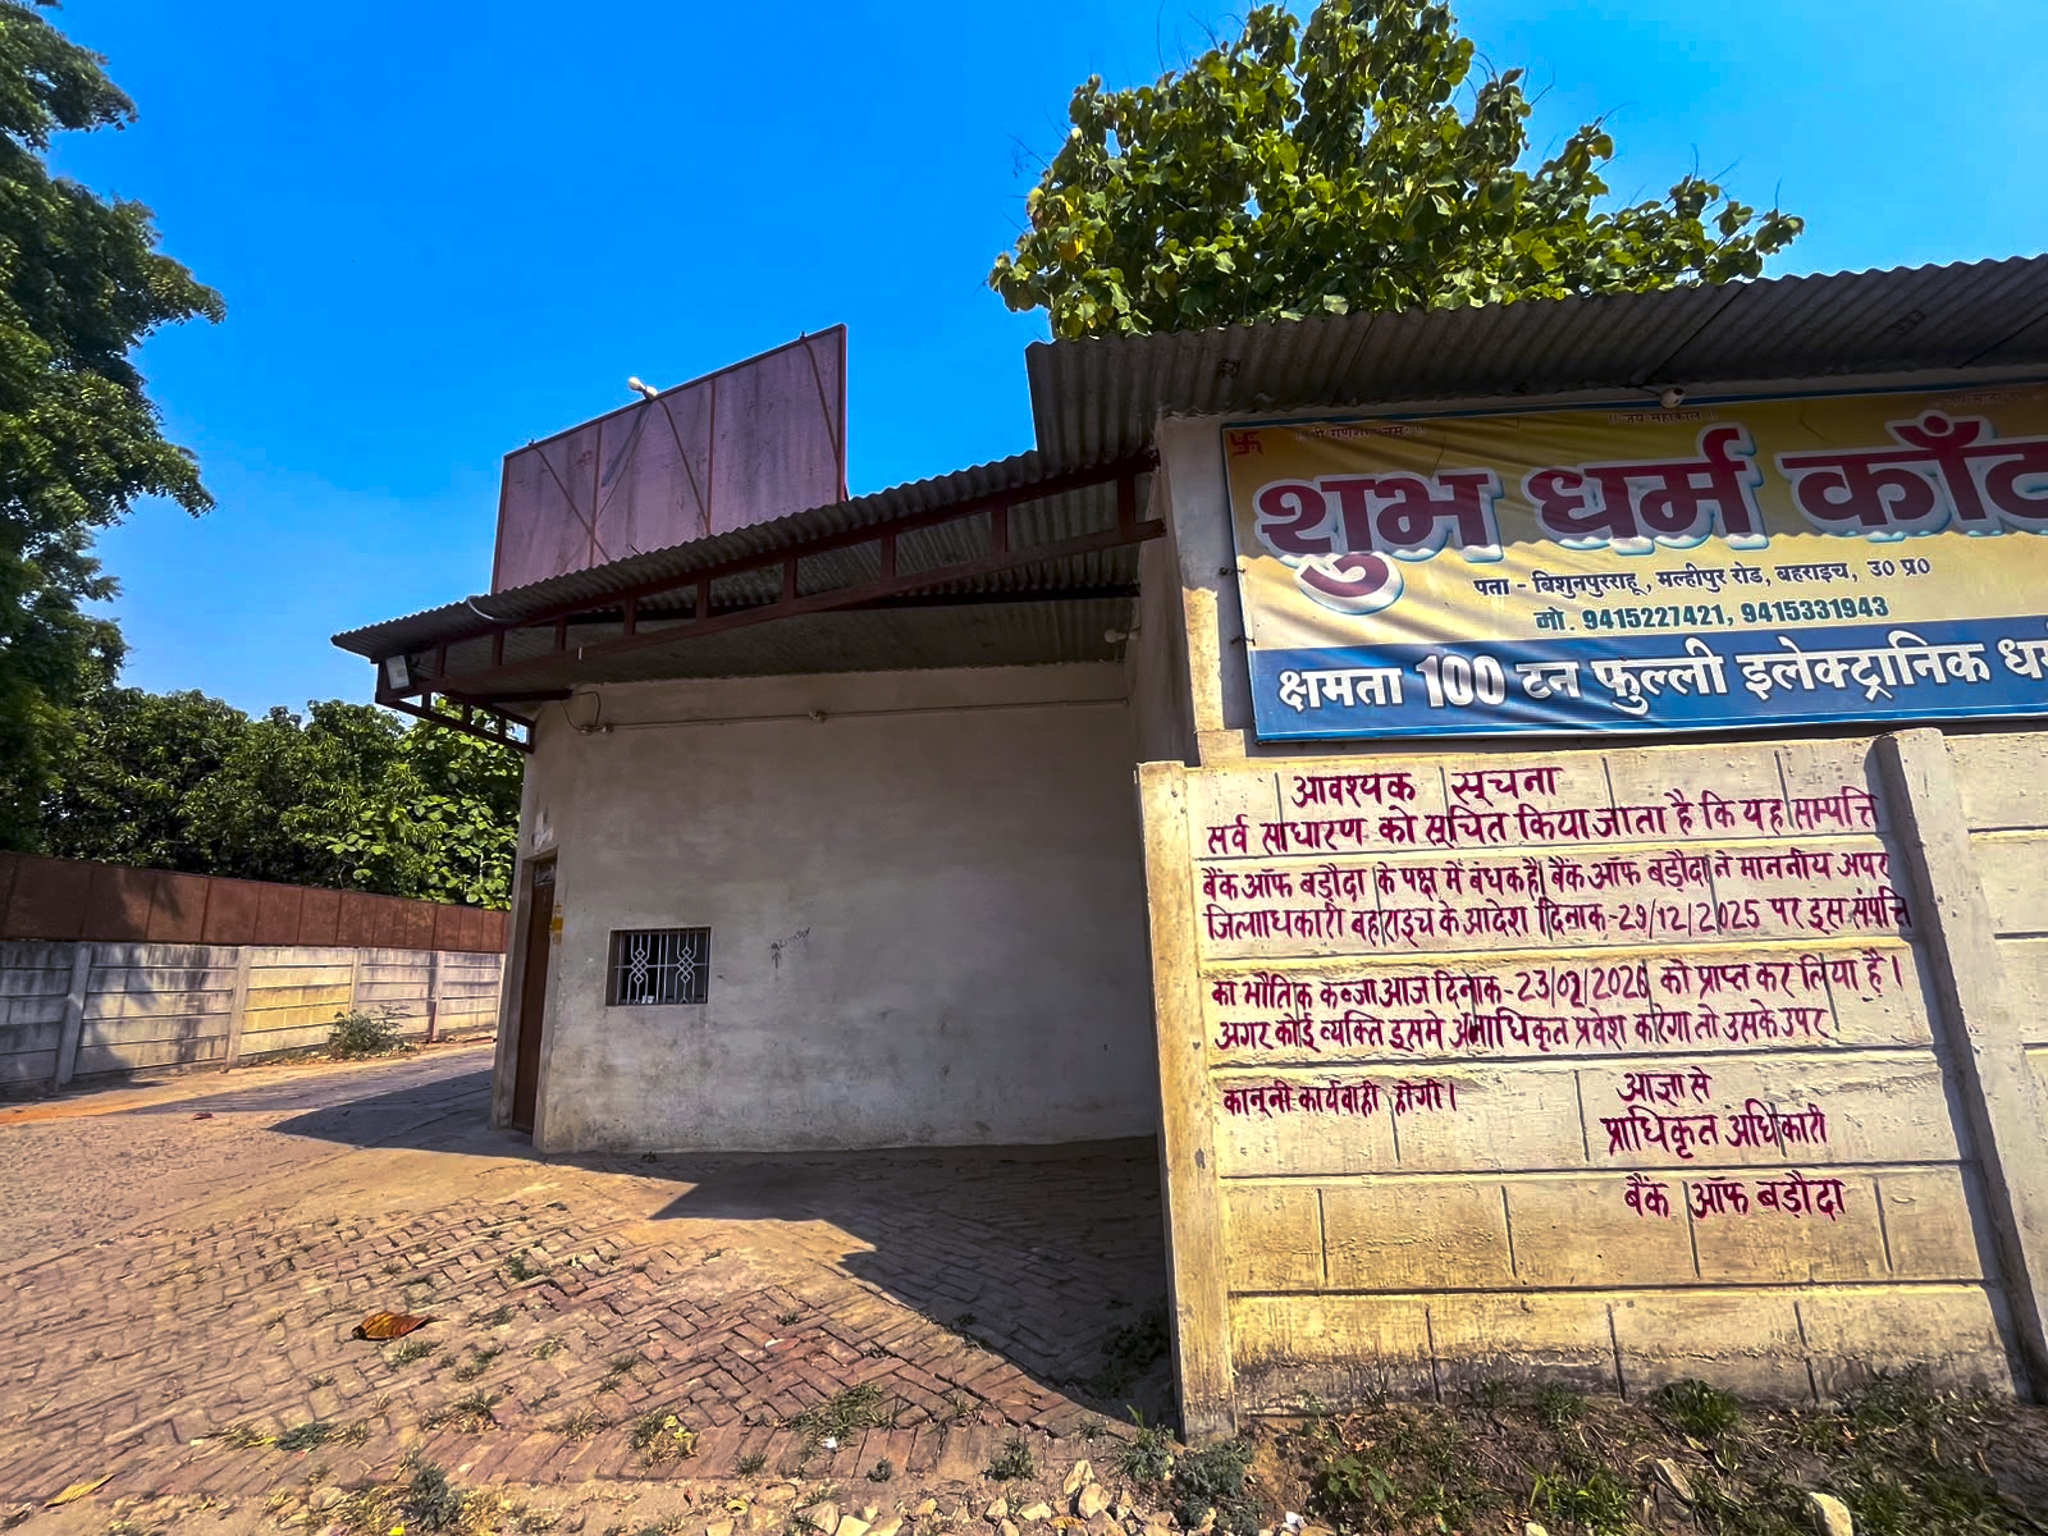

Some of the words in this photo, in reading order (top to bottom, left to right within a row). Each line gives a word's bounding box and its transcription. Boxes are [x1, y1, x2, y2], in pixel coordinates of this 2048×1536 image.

[1259, 473, 1489, 599] शुभ
[1526, 427, 1754, 540] धर्म
[1474, 578, 1510, 596] पता
[1656, 562, 1726, 592] मल्हीपुर
[1741, 596, 1889, 622] 9415331943
[1279, 668, 1402, 711] क्षमता
[1416, 656, 1505, 707] 100
[1516, 661, 1581, 698] टन
[1592, 637, 1727, 714] फुल्ली
[1736, 630, 1990, 700] इलेक्ट्रानिक
[1292, 772, 1415, 807] आवश्यक
[1451, 767, 1563, 806] सूचना
[1207, 814, 1249, 853] सर्व
[1260, 818, 1367, 852] साधारण
[1379, 805, 1417, 845] को
[1425, 805, 1508, 849] सूचित
[1513, 803, 1590, 840] किया
[1592, 806, 1667, 837] जाता
[1664, 789, 1694, 835] है
[1700, 790, 1735, 830] कि
[1738, 799, 1783, 835] यह
[1201, 866, 1238, 901] बैंक
[1241, 869, 1292, 898] ऑफ
[1377, 861, 1397, 895] के
[1400, 867, 1438, 901] पक्ष
[1441, 858, 1465, 895] में
[1548, 856, 1584, 892] बैंक
[1714, 850, 1735, 879] ने
[1736, 847, 1833, 880] माननीय
[1837, 852, 1890, 879] अपर
[1352, 908, 1436, 948] बहराइच
[1439, 900, 1459, 936] के
[1463, 899, 1528, 937] आदेश
[1766, 897, 1804, 929] पर
[1807, 897, 1850, 935] इस
[1211, 981, 1238, 1006] का
[1241, 971, 1312, 1009] भौतिक
[1379, 976, 1429, 1007] आज
[1660, 958, 1692, 994] को
[1695, 961, 1750, 999] प्राप्त
[1755, 961, 1795, 998] कर
[1800, 954, 1859, 998] लिया
[1215, 1021, 1274, 1050] अगर
[1275, 1013, 1321, 1052] कोई
[1320, 1009, 1385, 1048] व्यक्ति
[1573, 1007, 1627, 1050] प्रवेश
[1694, 1003, 1720, 1040] तो
[1723, 999, 1779, 1043] उसके
[1779, 1007, 1830, 1039] उपर
[1616, 1073, 1686, 1106] आज्ञा
[1687, 1066, 1712, 1103] से
[1600, 1105, 1719, 1158] प्राधिकृत
[1725, 1099, 1827, 1147] अधिकारी
[1624, 1173, 1669, 1217] बैंक
[1689, 1177, 1748, 1219] ऑफ
